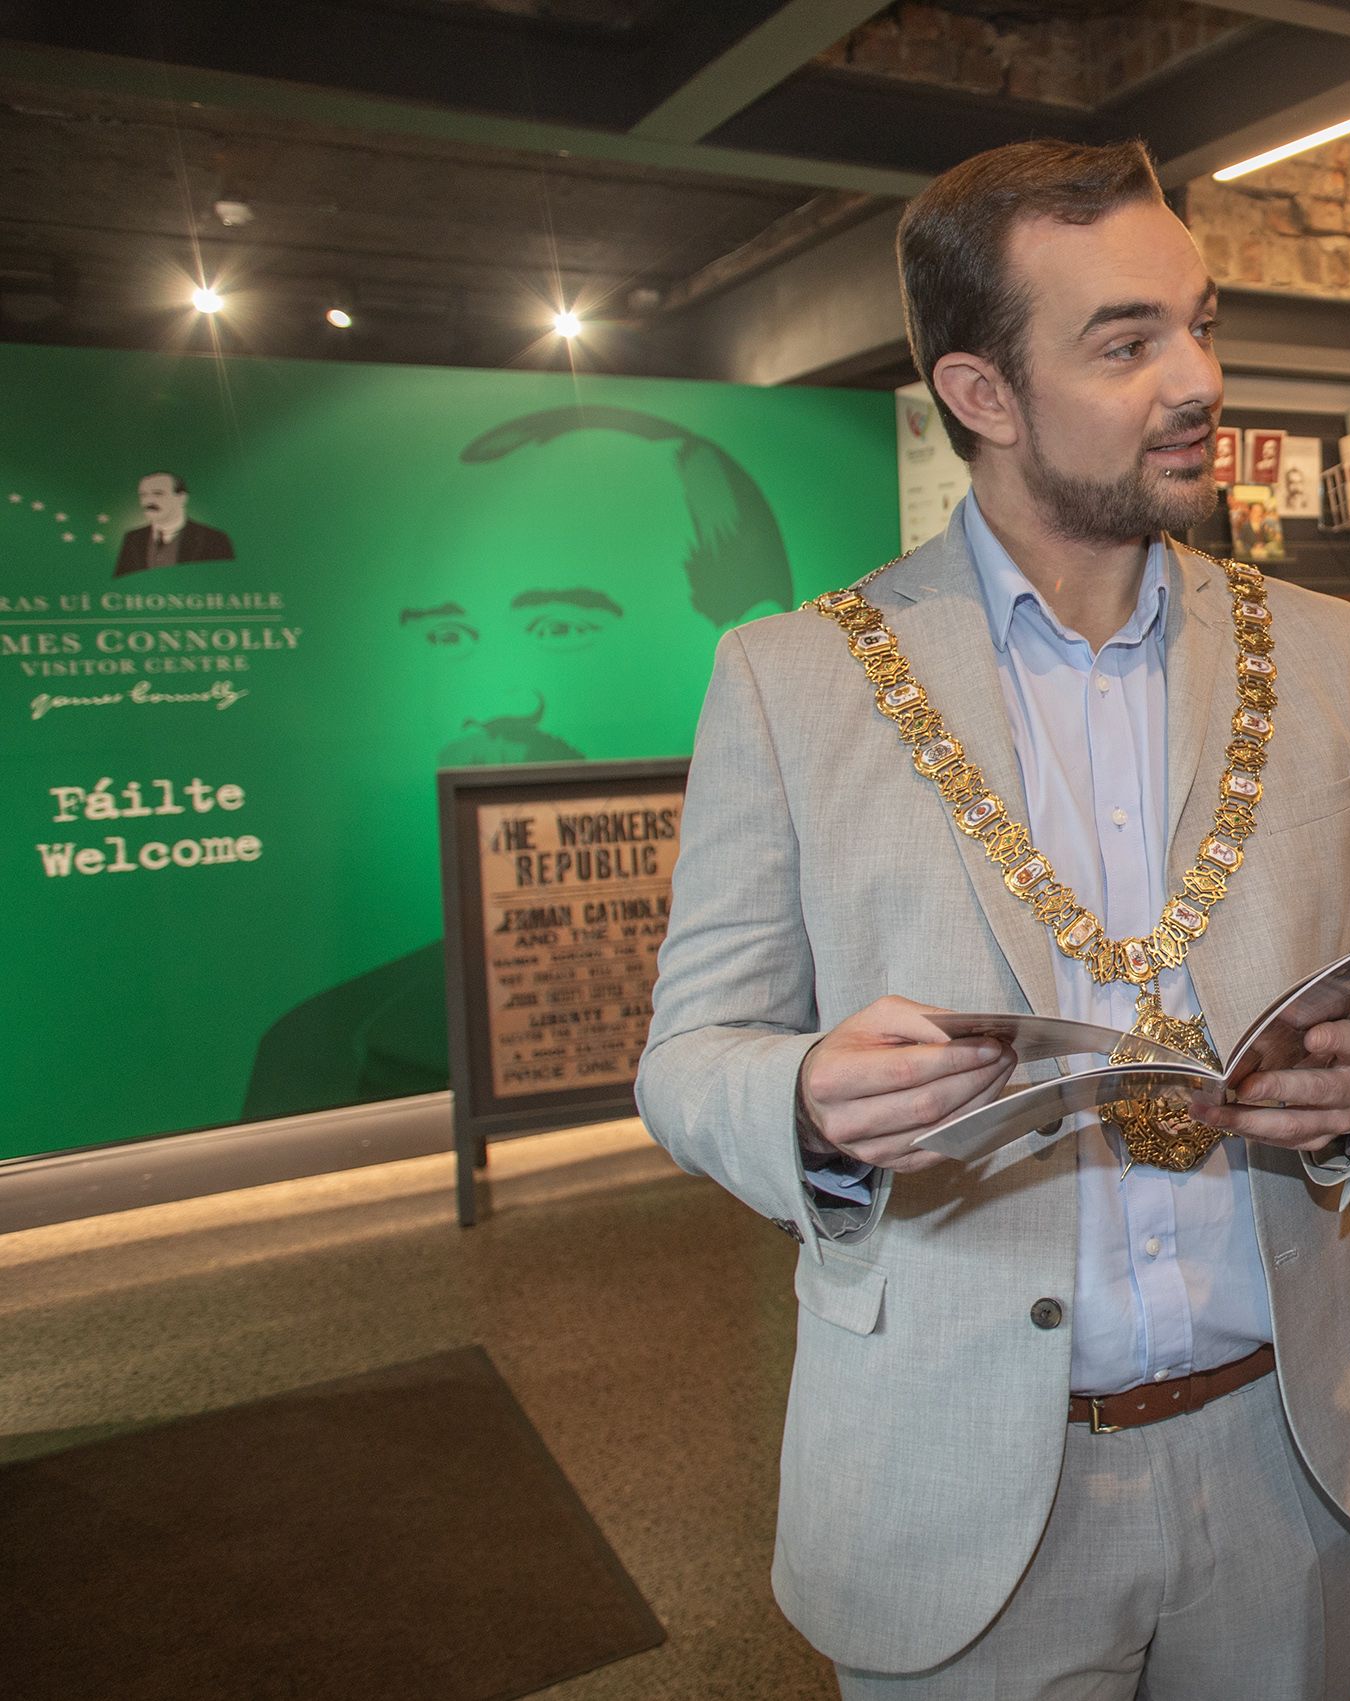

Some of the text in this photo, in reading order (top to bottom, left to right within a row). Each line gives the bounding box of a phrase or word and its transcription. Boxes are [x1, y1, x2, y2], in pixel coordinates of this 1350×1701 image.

[95, 627, 303, 653] CONNOLLY
[20, 655, 250, 678] VISITOR CENTRE
[49, 777, 245, 823] Fáilte
[36, 835, 263, 878] Welcome
[515, 846, 658, 888] REPUBLIC
